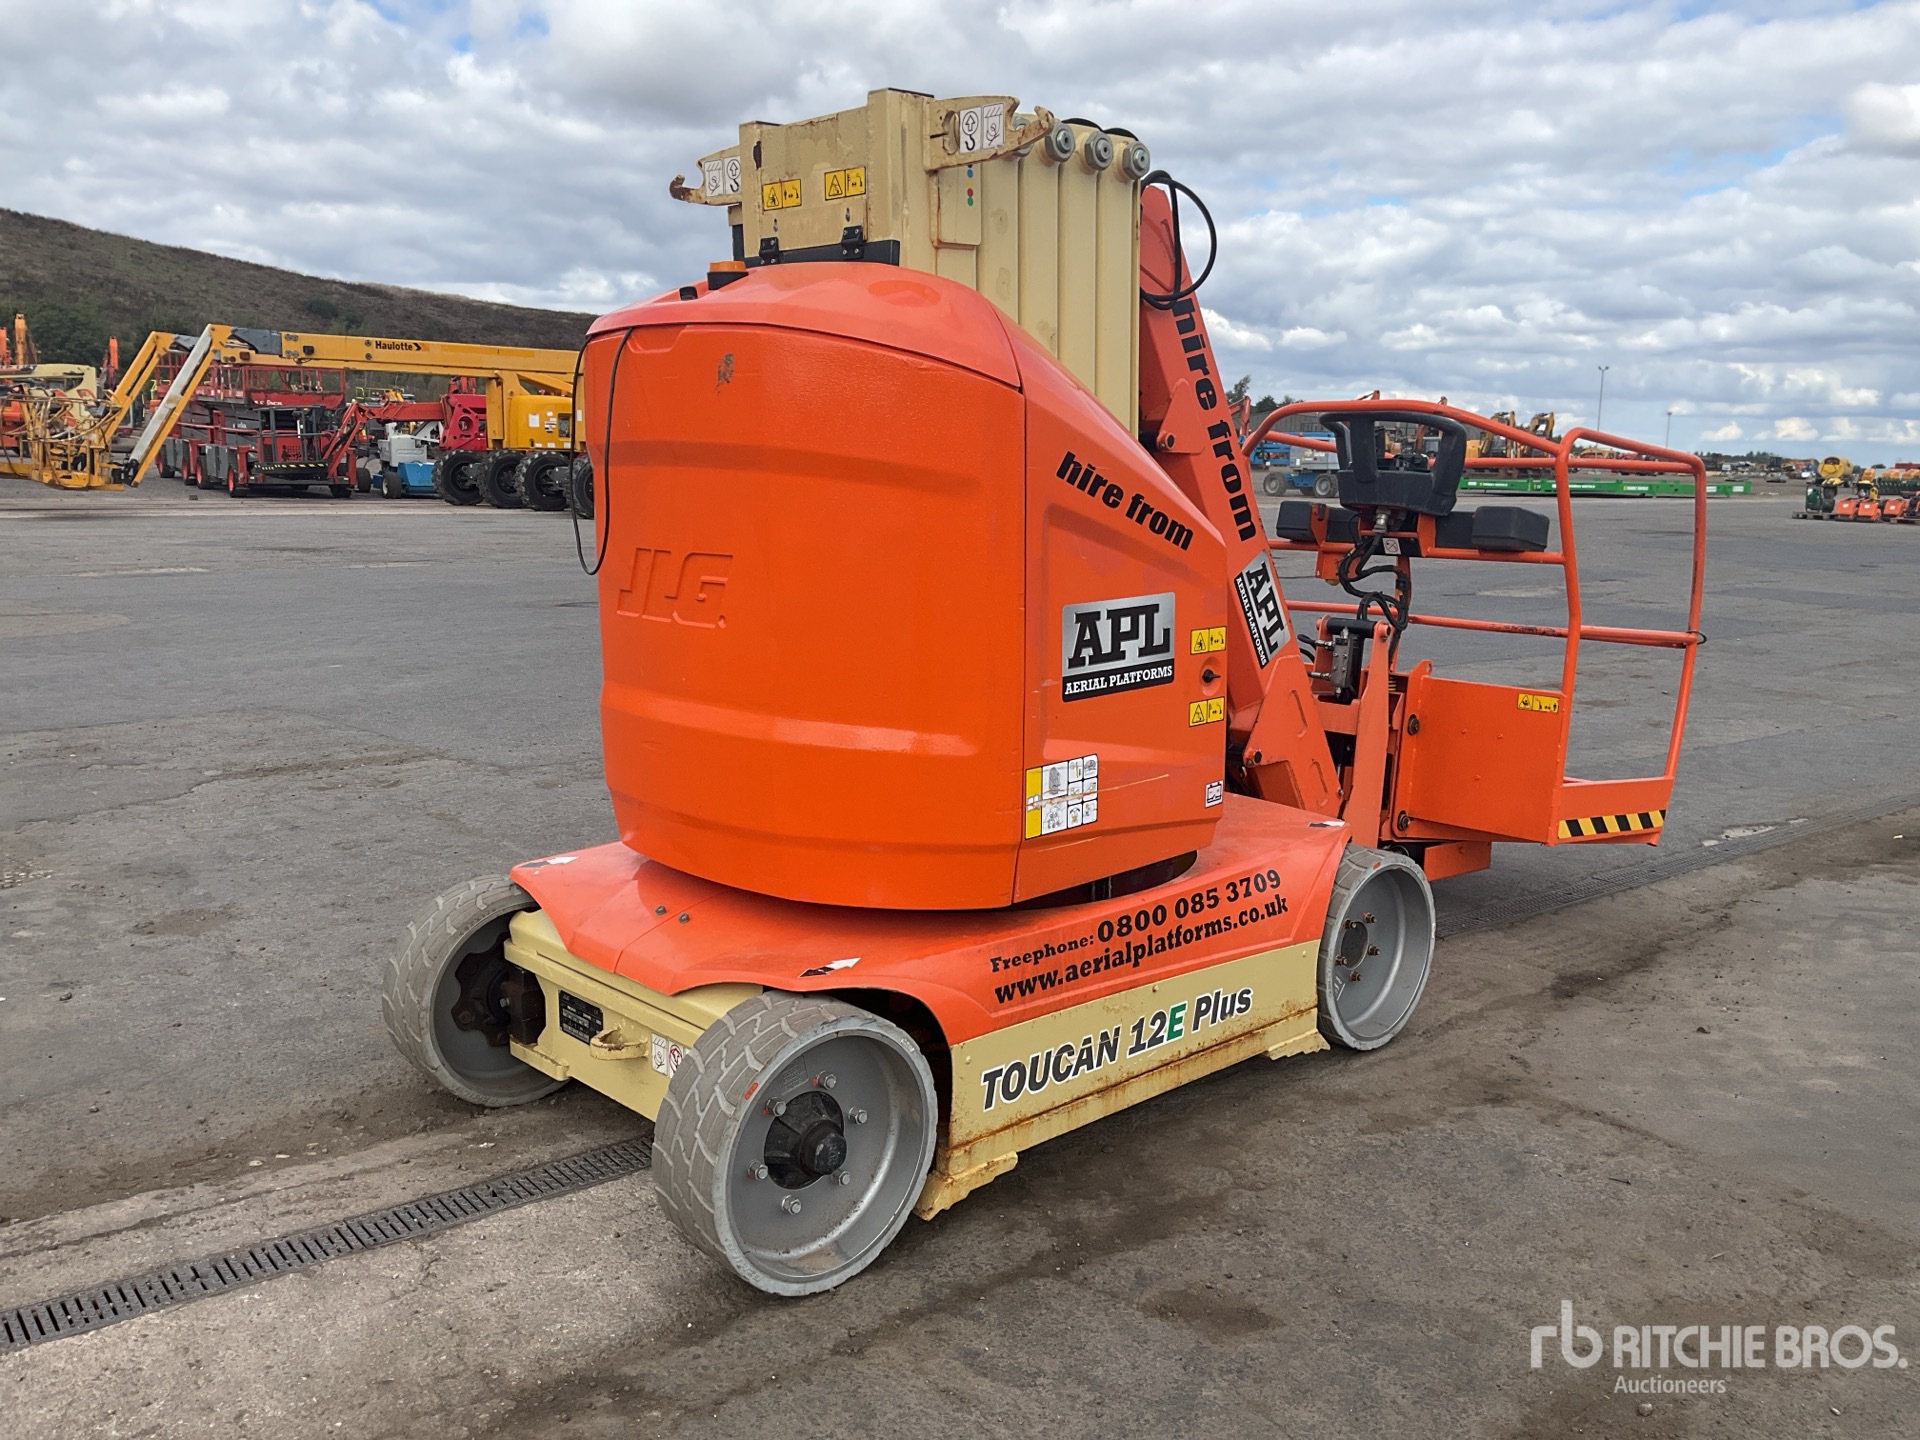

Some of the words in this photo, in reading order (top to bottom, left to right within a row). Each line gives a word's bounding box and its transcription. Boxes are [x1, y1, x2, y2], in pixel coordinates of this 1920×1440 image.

[375, 340, 413, 351] Haulotte
[1172, 298, 1217, 411] hire
[1207, 419, 1257, 542] from
[1056, 451, 1125, 510] hire
[1126, 492, 1194, 551] from
[1067, 603, 1171, 670] APL
[1236, 577, 1251, 612] AERIAL
[1246, 610, 1268, 666] PLATFORMS
[1246, 561, 1285, 655] APL
[1064, 678, 1108, 696] AERIAL
[1109, 665, 1173, 688] PLATFORMS
[990, 935, 1094, 972] Freephone:
[1097, 904, 1167, 942] 0800
[1174, 887, 1219, 919] 085
[1226, 869, 1281, 902] 3709
[995, 894, 1288, 1004] www.aerialplatforms.co.uk
[982, 1026, 1121, 1110] TOUCAN
[1128, 1003, 1187, 1058] 12E
[1192, 987, 1253, 1031] Plus
